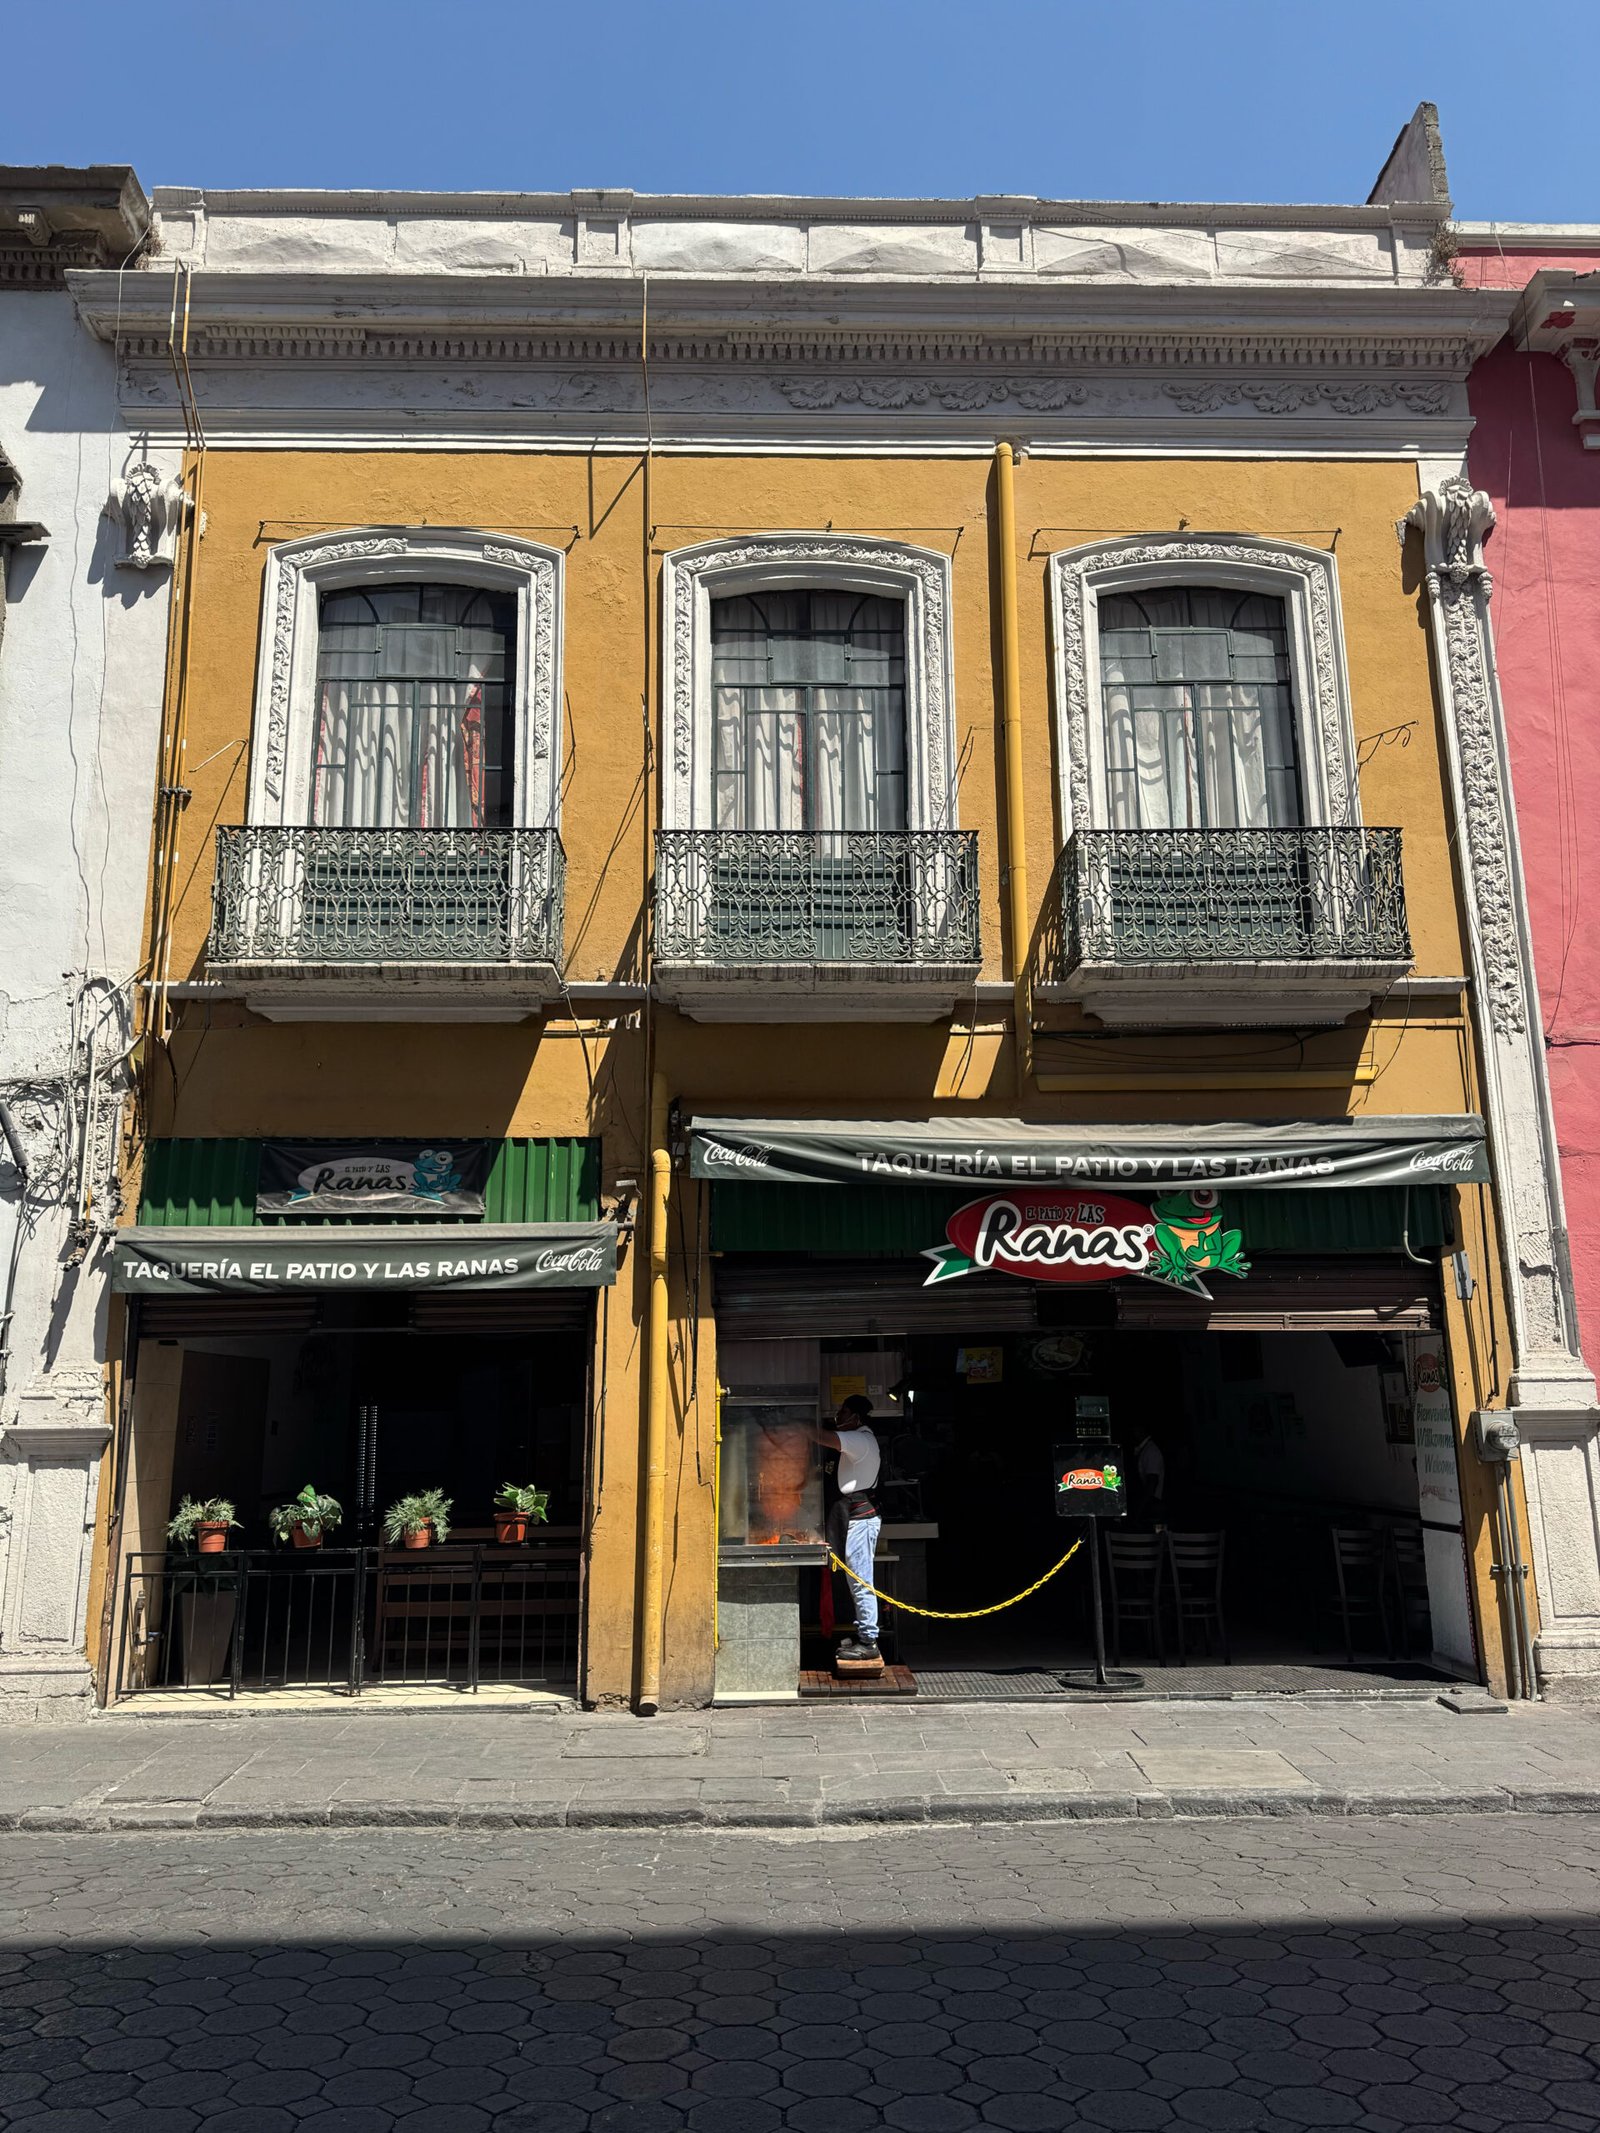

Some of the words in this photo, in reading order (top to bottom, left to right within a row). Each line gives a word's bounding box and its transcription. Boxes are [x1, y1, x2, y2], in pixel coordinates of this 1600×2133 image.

[375, 1164, 391, 1174] LAS
[856, 1149, 1003, 1175] TAQUERÍA
[1011, 1155, 1047, 1176] EL
[1055, 1156, 1139, 1177] PATIO
[1143, 1157, 1165, 1177] Y
[1172, 1157, 1227, 1177] LAS
[1235, 1156, 1336, 1177] RANAS
[1410, 1148, 1477, 1172] Coca-Cola
[313, 1167, 407, 1194] Ranas
[1026, 1206, 1036, 1220] EL
[1039, 1206, 1062, 1221] PATIO
[1065, 1207, 1074, 1221] Y
[1078, 1203, 1105, 1224] LAS
[980, 1204, 1145, 1265] Ranas
[122, 1258, 243, 1281] TAQUERÍA
[250, 1262, 280, 1280] EL
[286, 1262, 359, 1280] PATIO
[362, 1262, 380, 1280] Y
[384, 1261, 431, 1279] LAS
[436, 1258, 519, 1277] RANAS
[536, 1247, 606, 1273] Coca-Cola
[1068, 1473, 1102, 1486] Ranas
